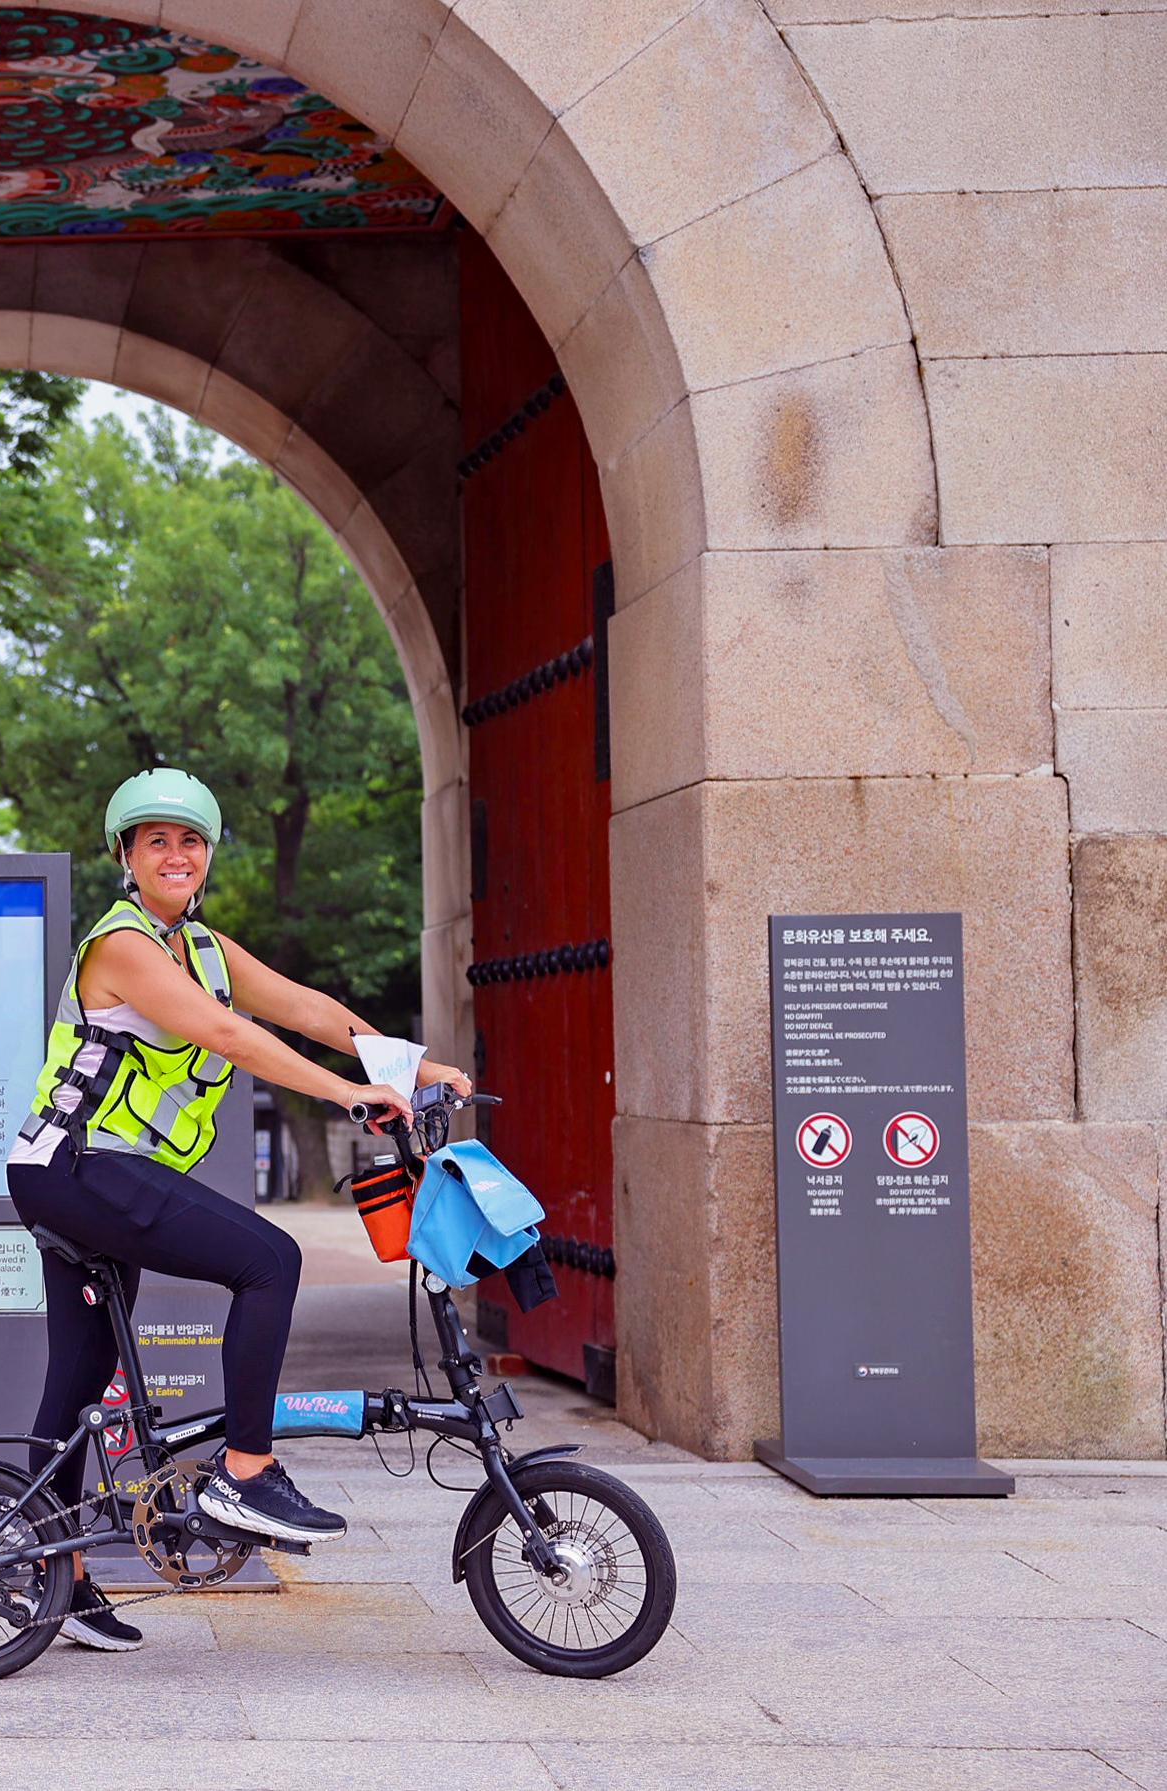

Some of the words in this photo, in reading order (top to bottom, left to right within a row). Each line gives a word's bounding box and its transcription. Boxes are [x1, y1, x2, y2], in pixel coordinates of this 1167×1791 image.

[783, 929, 845, 945] 문화유산을
[849, 929, 886, 943] 보호해
[891, 928, 932, 943] 주세요.
[815, 983, 822, 992] 시
[903, 983, 910, 991] 수
[807, 1175, 842, 1185] 낙서금지
[932, 1175, 948, 1185] 금지
[138, 1324, 174, 1335] 인화물질
[177, 1324, 213, 1335] 반입금지
[139, 1337, 150, 1345] No
[153, 1337, 196, 1345] Flammable
[169, 1375, 205, 1386] 반입금지
[156, 1388, 183, 1397] Eating
[283, 1396, 349, 1415] WeRide
[211, 1476, 242, 1502] HOKA
